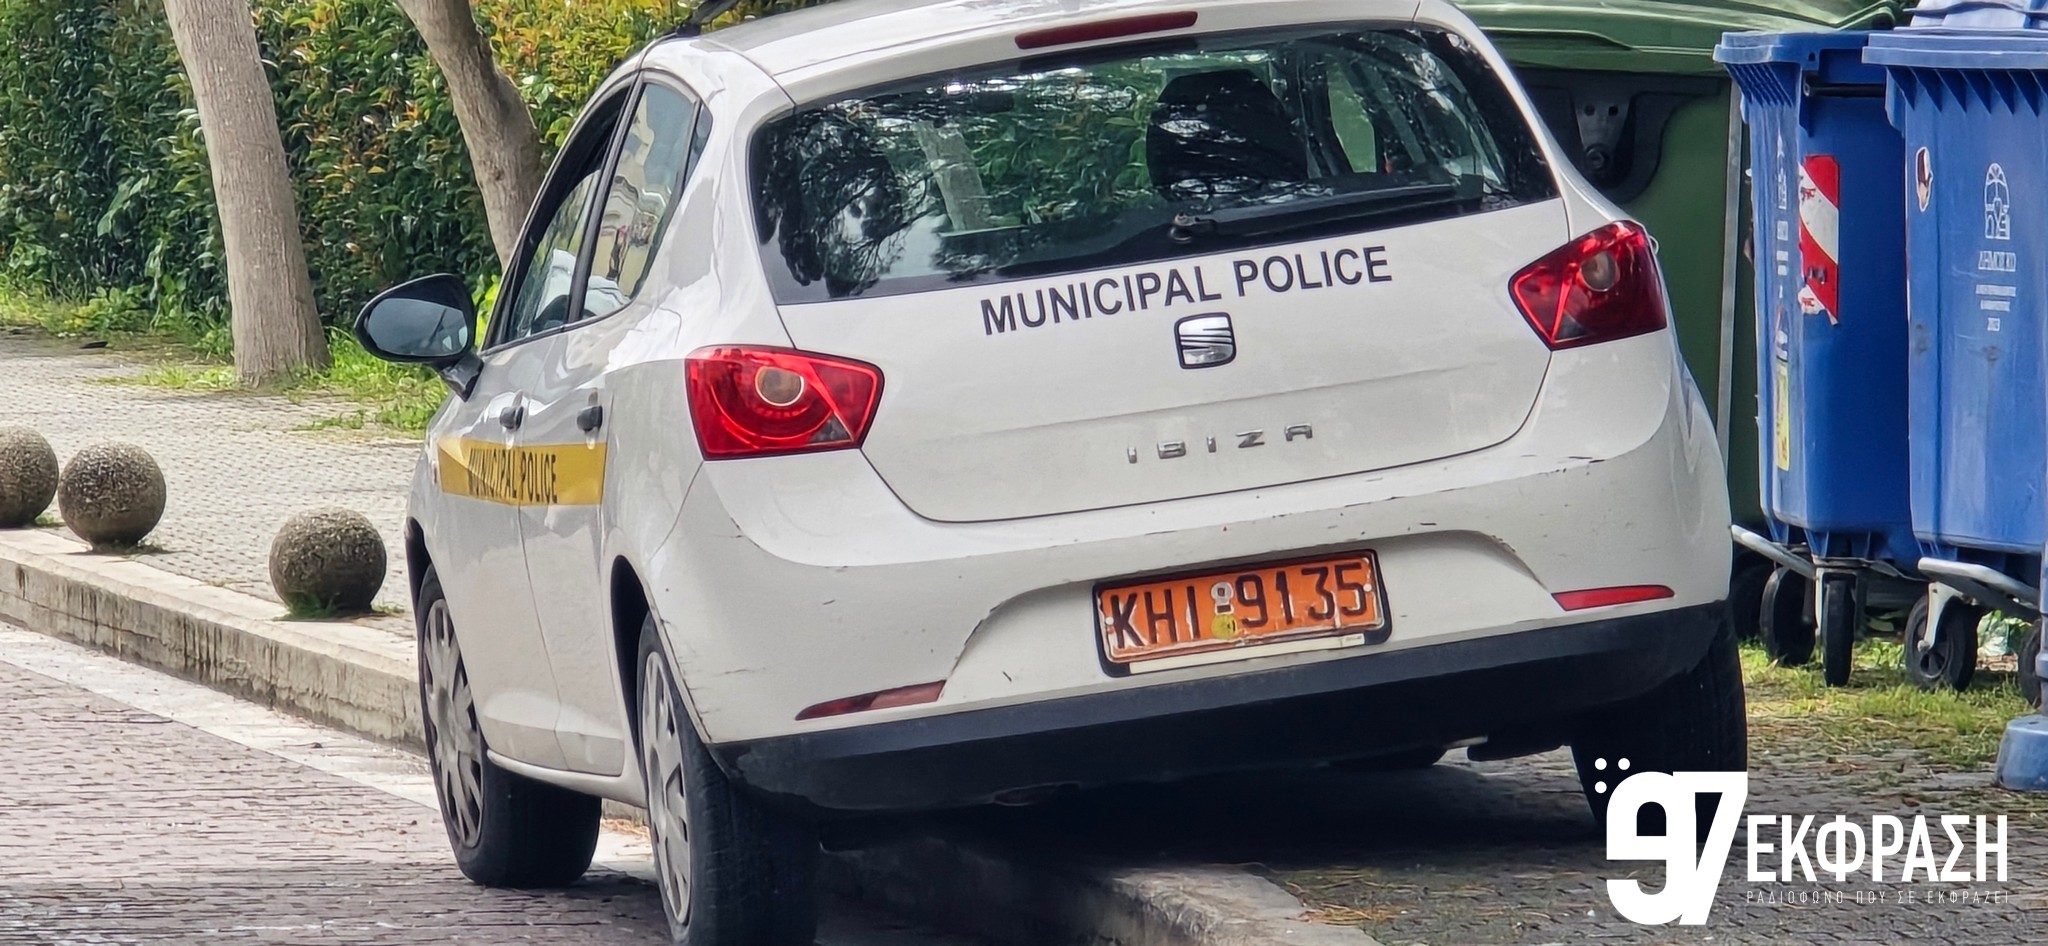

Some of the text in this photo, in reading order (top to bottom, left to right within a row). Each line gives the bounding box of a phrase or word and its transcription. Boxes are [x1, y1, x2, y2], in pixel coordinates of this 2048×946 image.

[980, 245, 1393, 335] MUNICIPAL POLICE
[1127, 422, 1314, 464] IBIZA
[467, 447, 558, 504] MUNICIPAL POLICE
[1235, 561, 1369, 629] 9135
